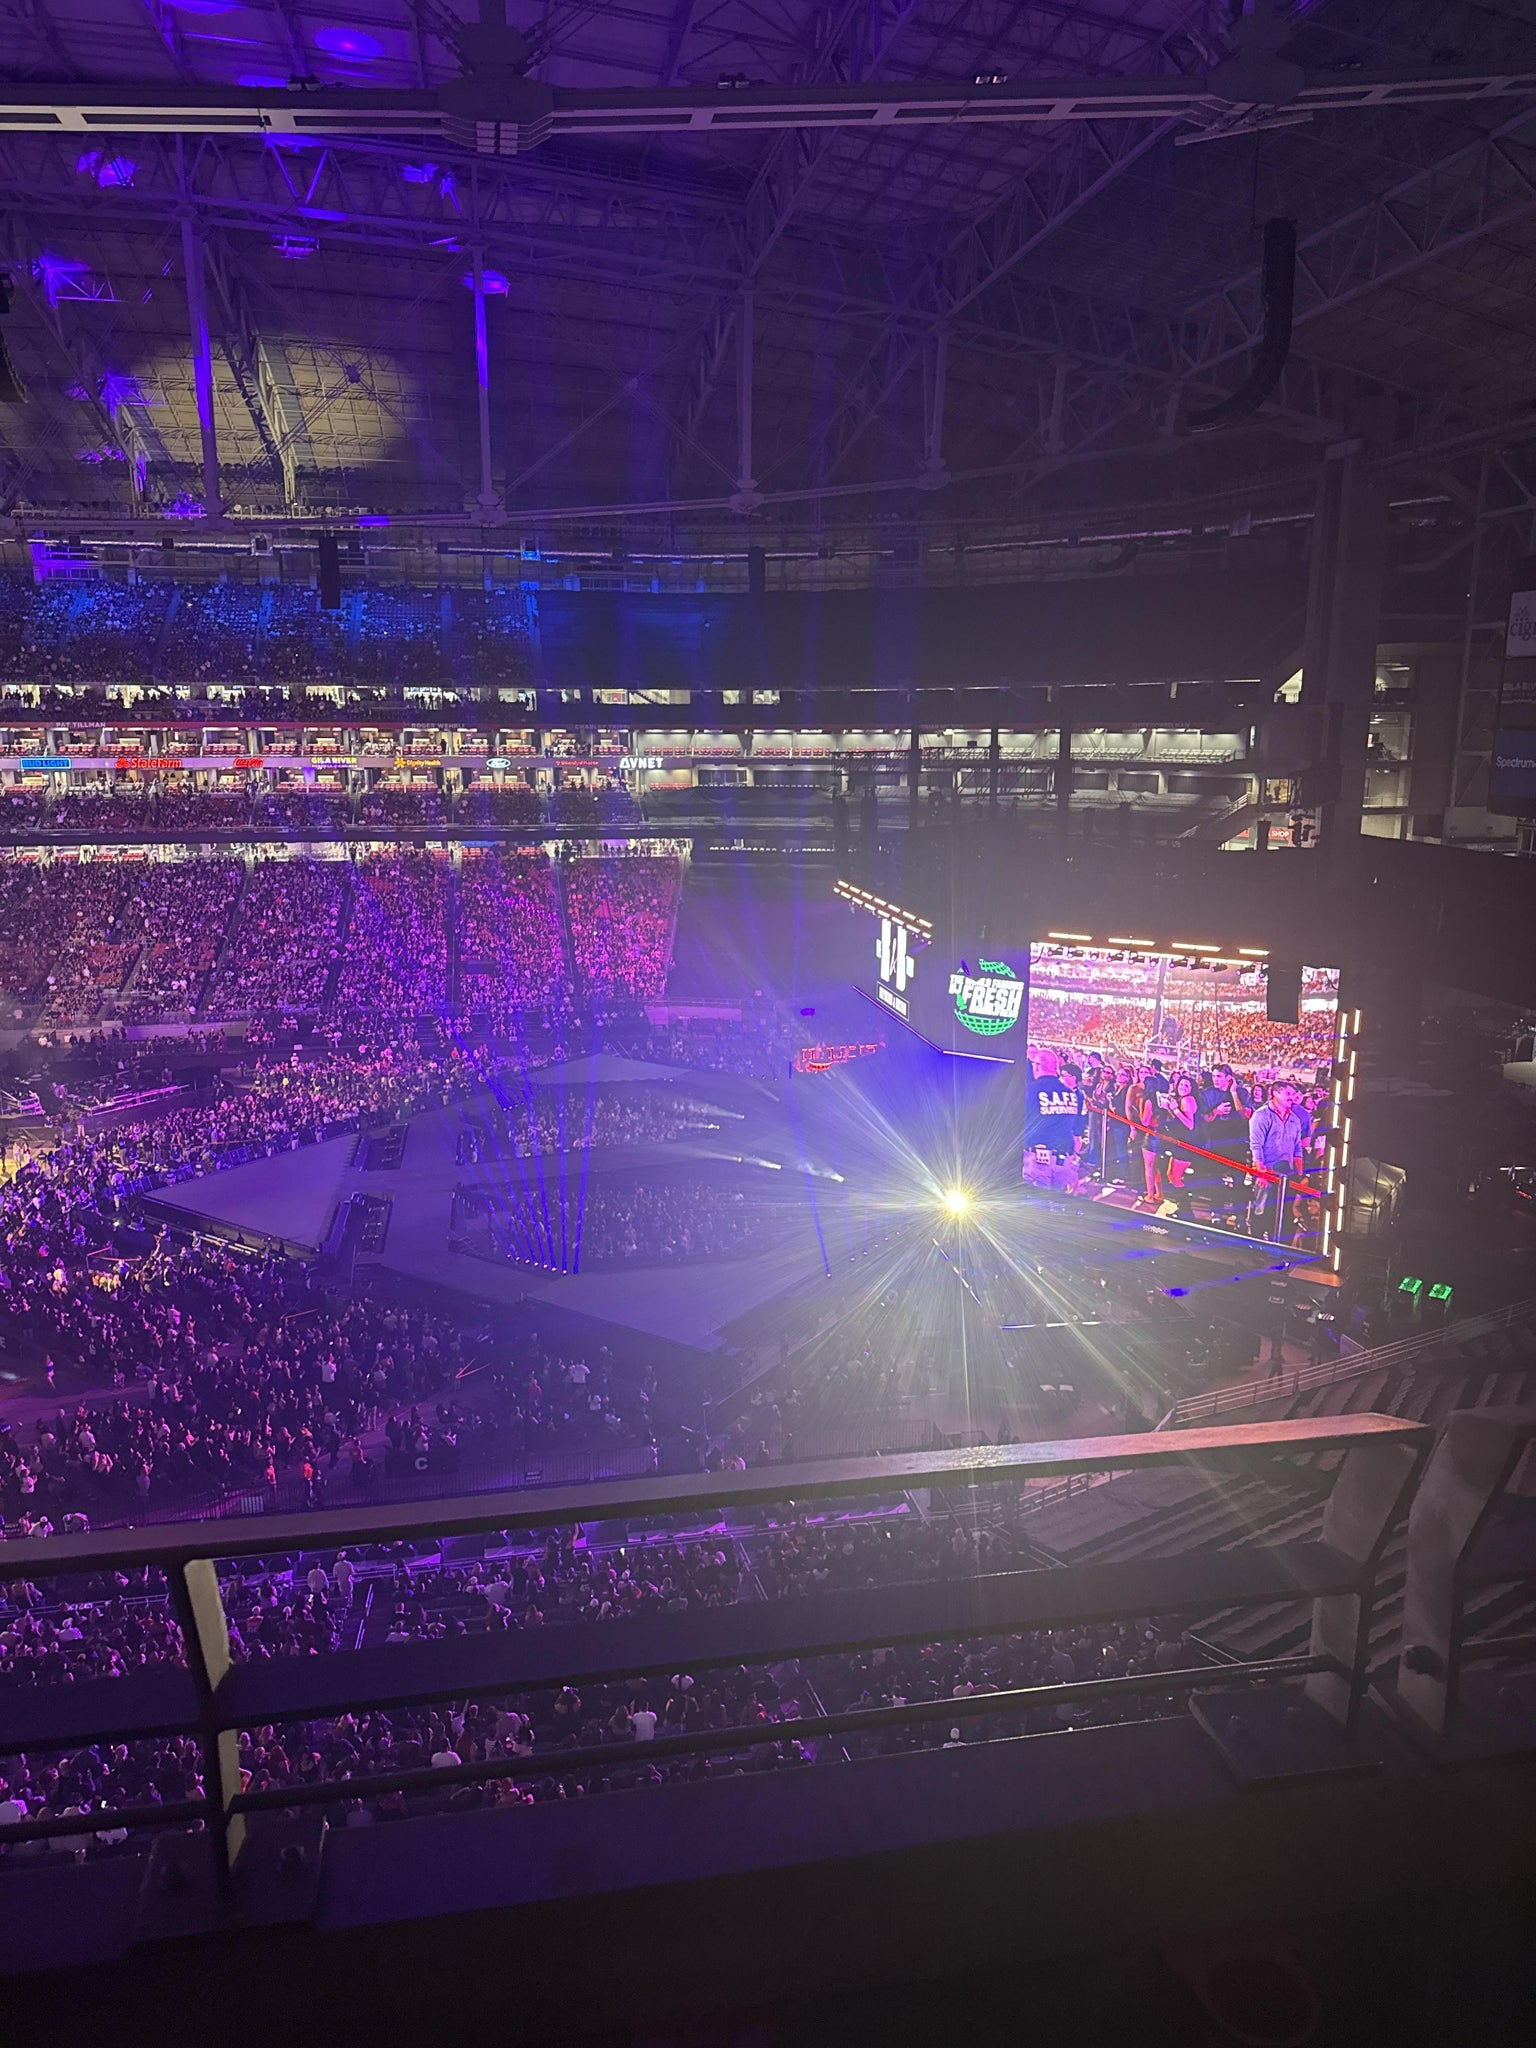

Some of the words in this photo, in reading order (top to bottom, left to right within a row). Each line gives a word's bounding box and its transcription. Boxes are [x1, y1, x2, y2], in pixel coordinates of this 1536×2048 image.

[619, 757, 664, 769] AVNET
[1496, 756, 1535, 769] Spectrum
[962, 985, 1022, 1014] FRESH
[414, 1457, 428, 1470] C
